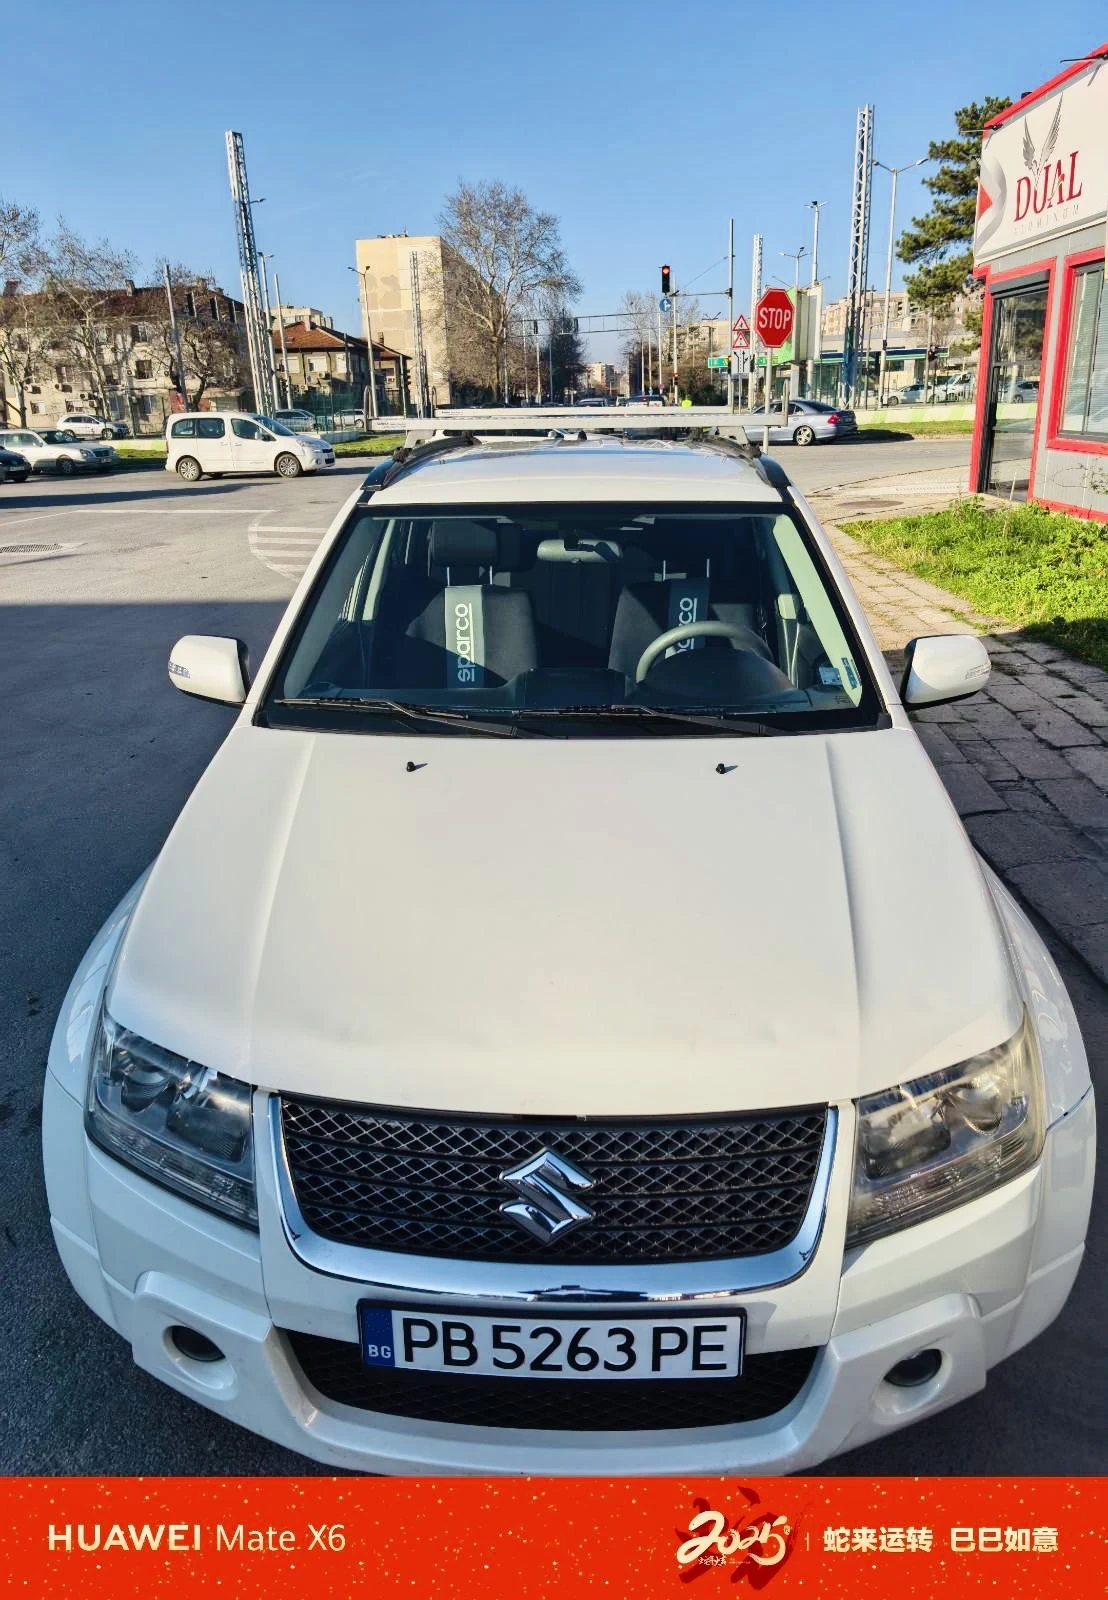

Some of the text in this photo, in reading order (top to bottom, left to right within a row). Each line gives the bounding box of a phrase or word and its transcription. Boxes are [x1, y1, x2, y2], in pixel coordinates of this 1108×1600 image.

[1013, 150, 1083, 222] DUAL
[758, 306, 791, 330] STOP
[455, 603, 474, 682] sparco
[368, 1344, 392, 1359] BG
[402, 1317, 727, 1372] PB 5263 PE
